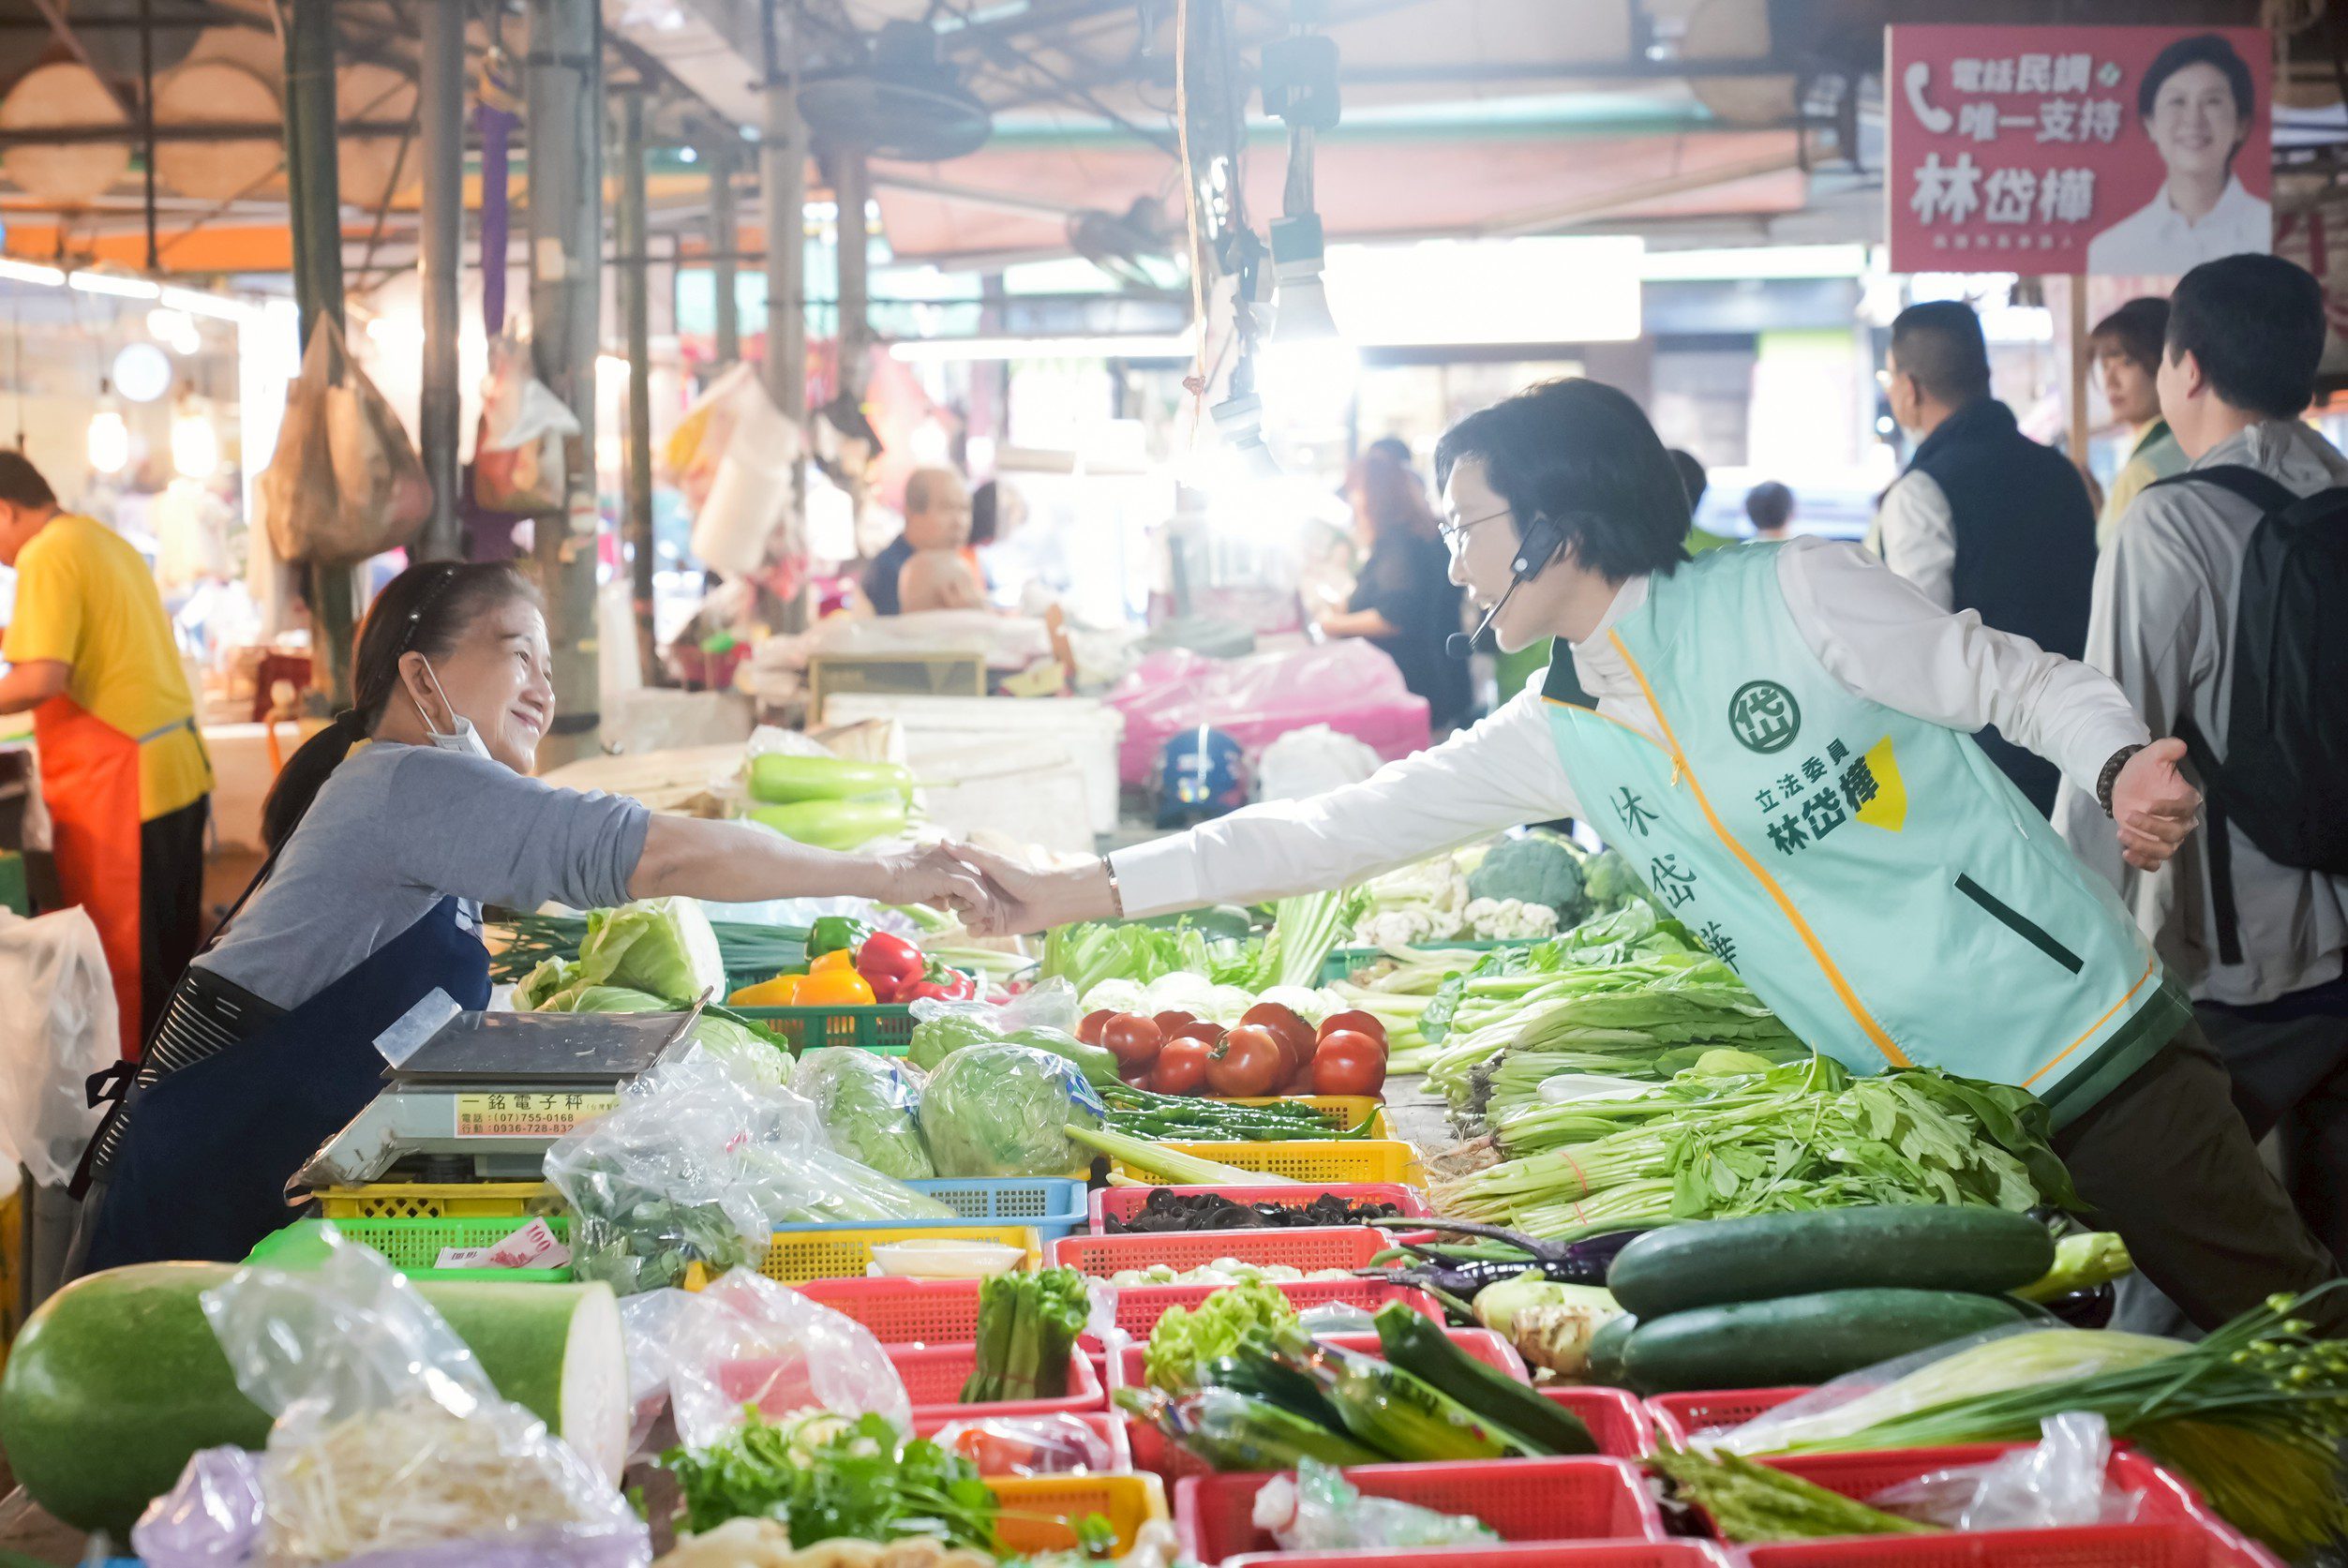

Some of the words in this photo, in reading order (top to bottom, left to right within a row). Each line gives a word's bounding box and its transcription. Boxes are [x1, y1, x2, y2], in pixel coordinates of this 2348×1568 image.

[1952, 53, 2091, 94] 電話民調
[1958, 98, 2122, 142] 唯一支持
[1910, 152, 2096, 225] 林岱樺
[1734, 687, 1786, 747] 岱
[1755, 738, 1850, 814] 立法委員
[1766, 755, 1879, 857] 林岱樺
[461, 1094, 583, 1111] 一銘電子秤
[526, 1224, 551, 1252] 100
